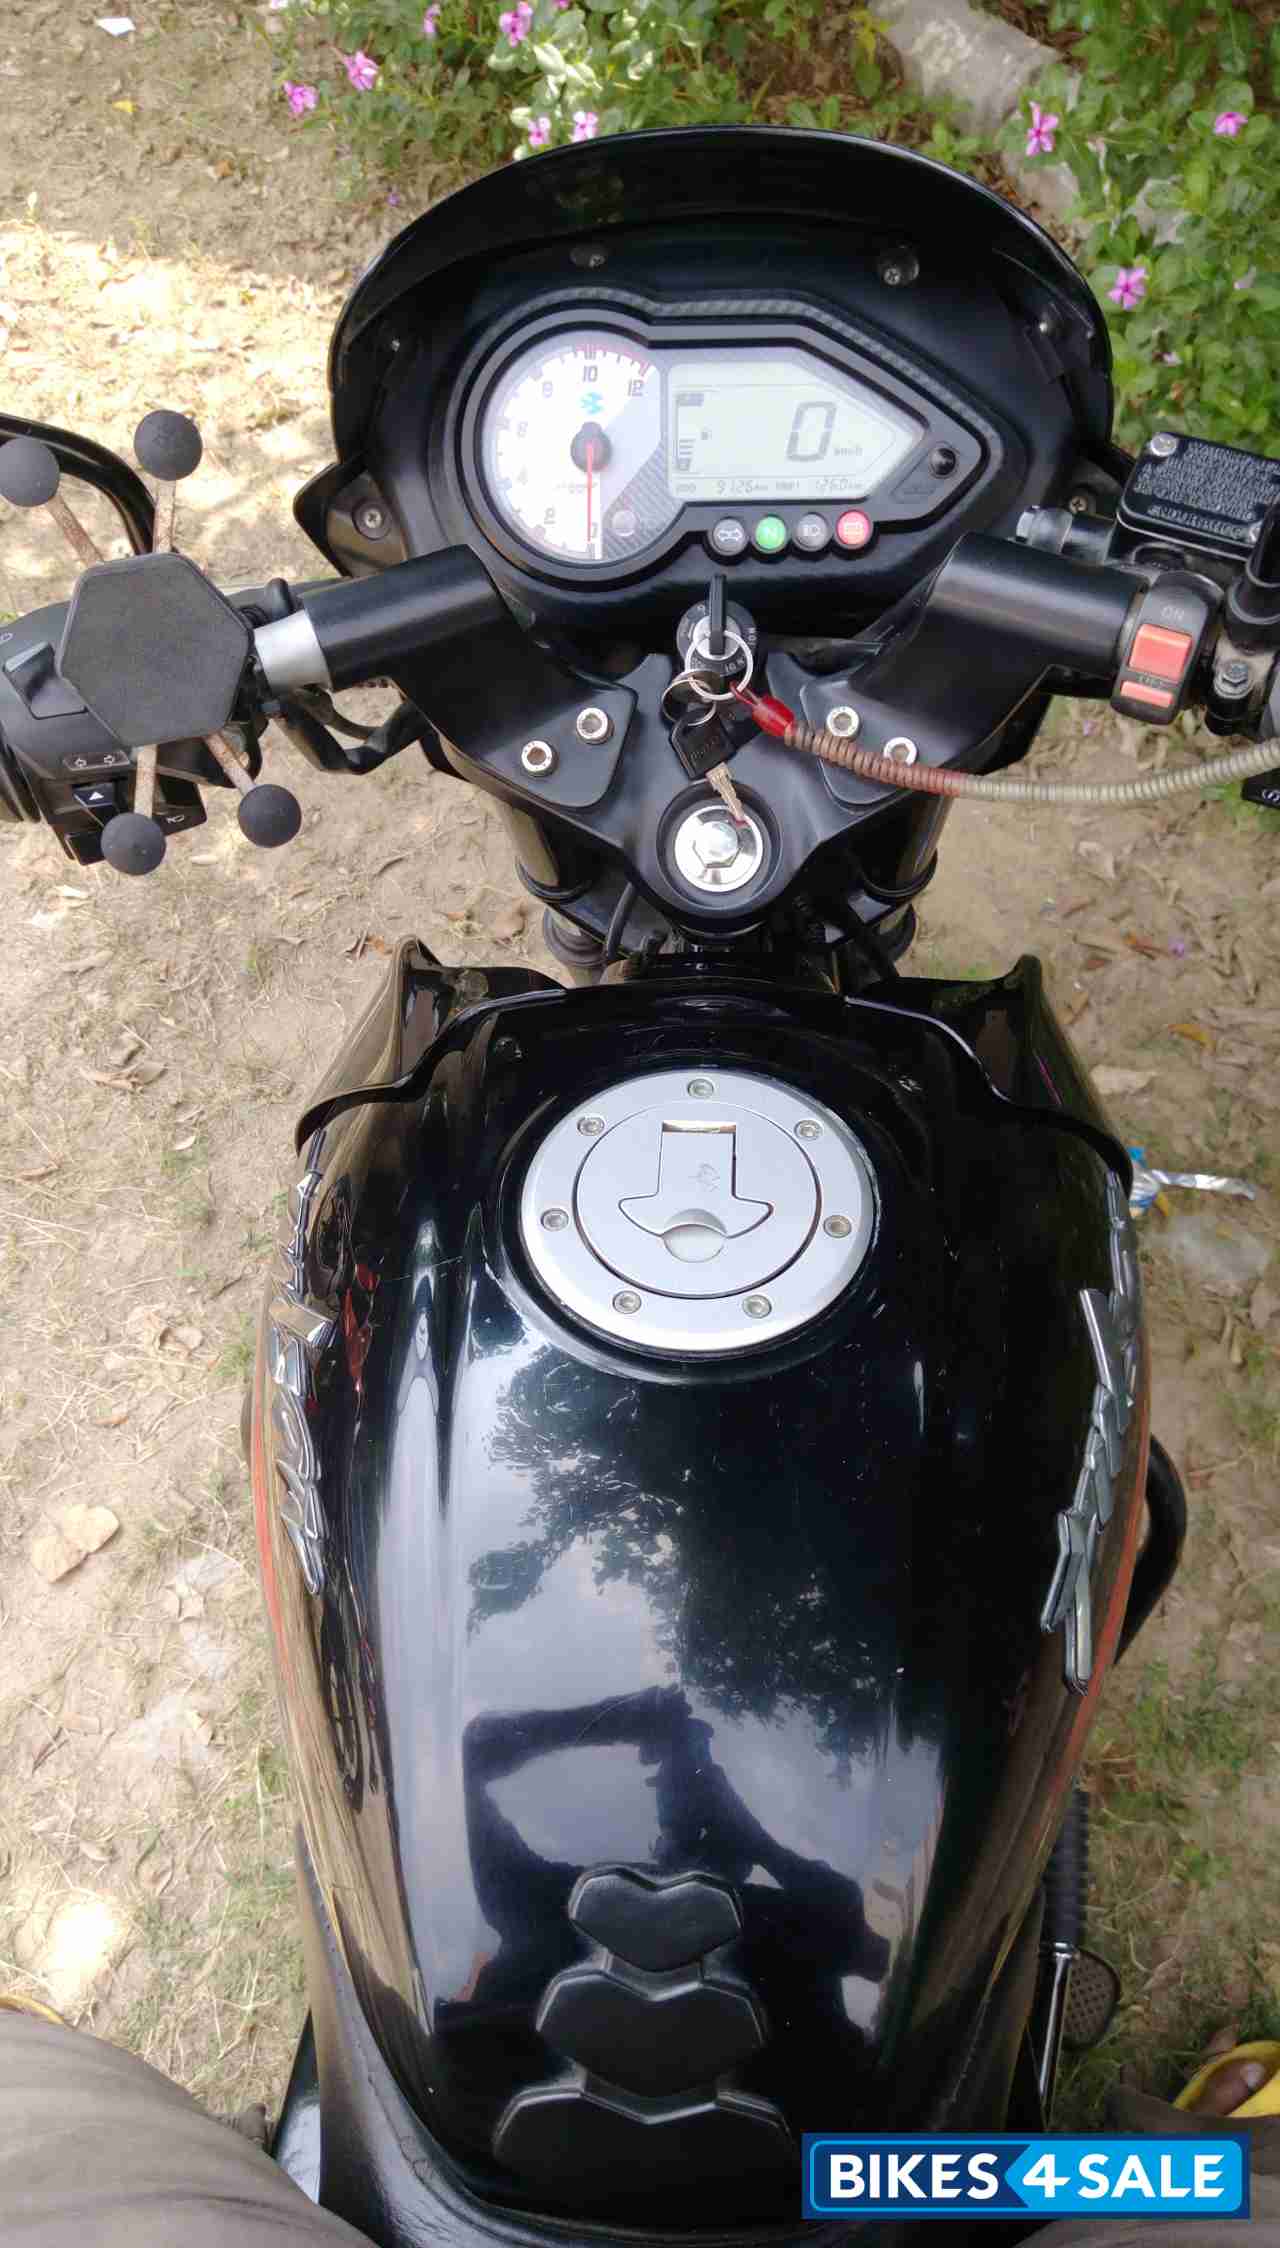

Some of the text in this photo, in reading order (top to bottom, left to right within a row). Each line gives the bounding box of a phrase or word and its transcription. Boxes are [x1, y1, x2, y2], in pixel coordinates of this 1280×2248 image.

[582, 365, 599, 382] 10
[627, 379, 644, 397] 12
[785, 400, 838, 463] 0
[1160, 605, 1186, 622] ON
